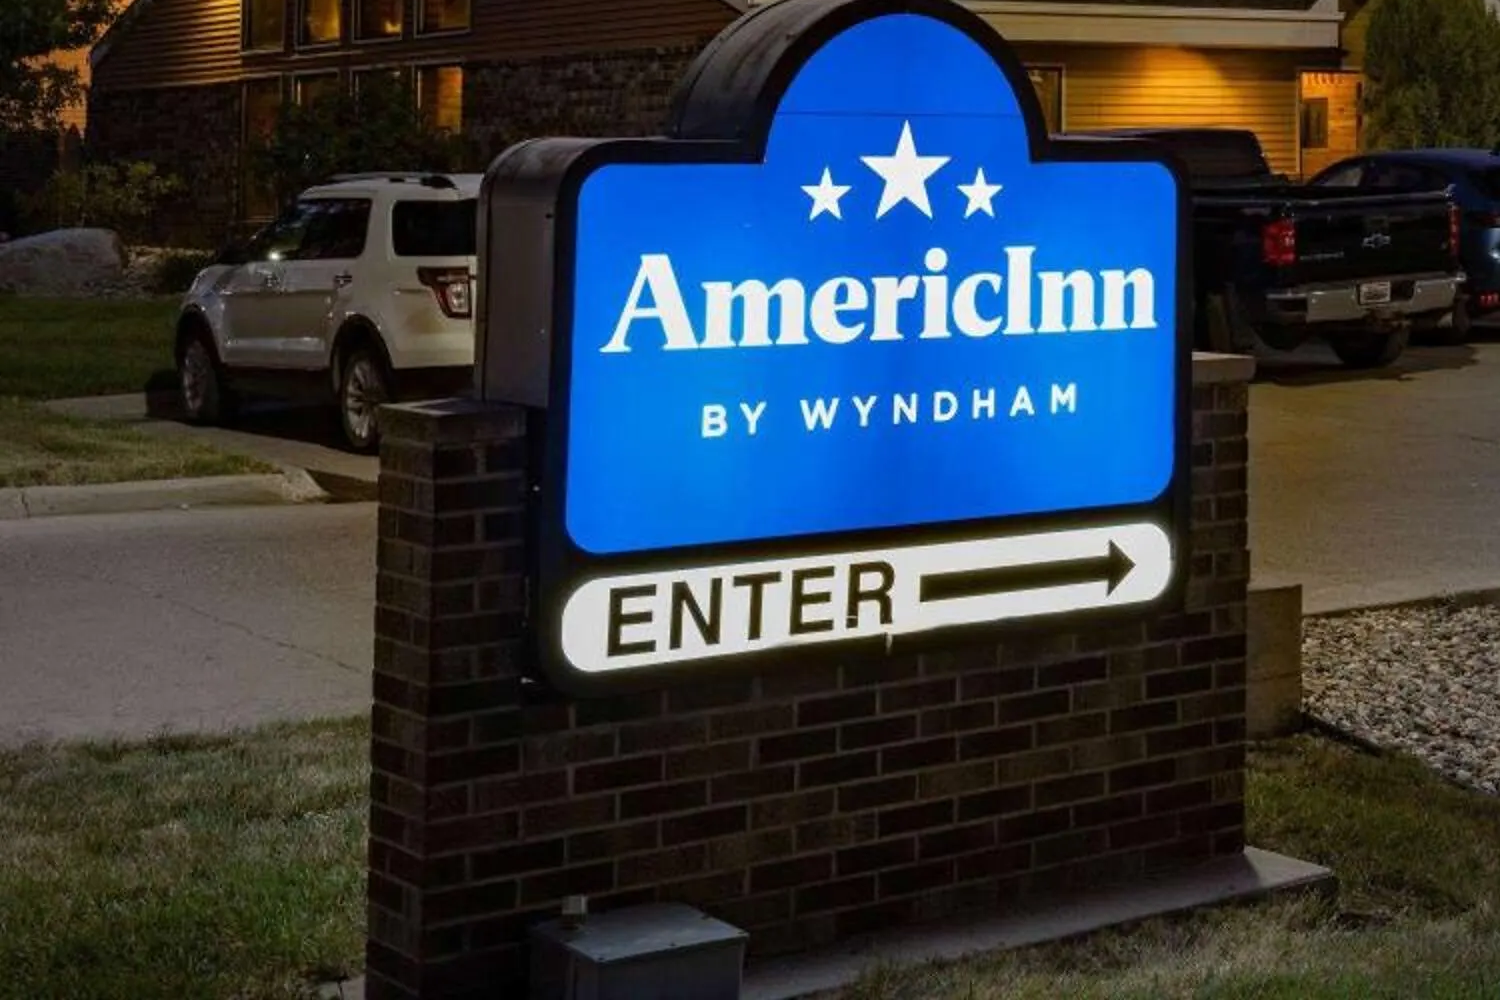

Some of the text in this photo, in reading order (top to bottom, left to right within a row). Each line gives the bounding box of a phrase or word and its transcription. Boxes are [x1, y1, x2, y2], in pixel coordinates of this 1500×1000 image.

[600, 245, 1157, 353] AmericInn
[702, 383, 1077, 438] BY WYNDHAM
[607, 561, 895, 658] ENTER
